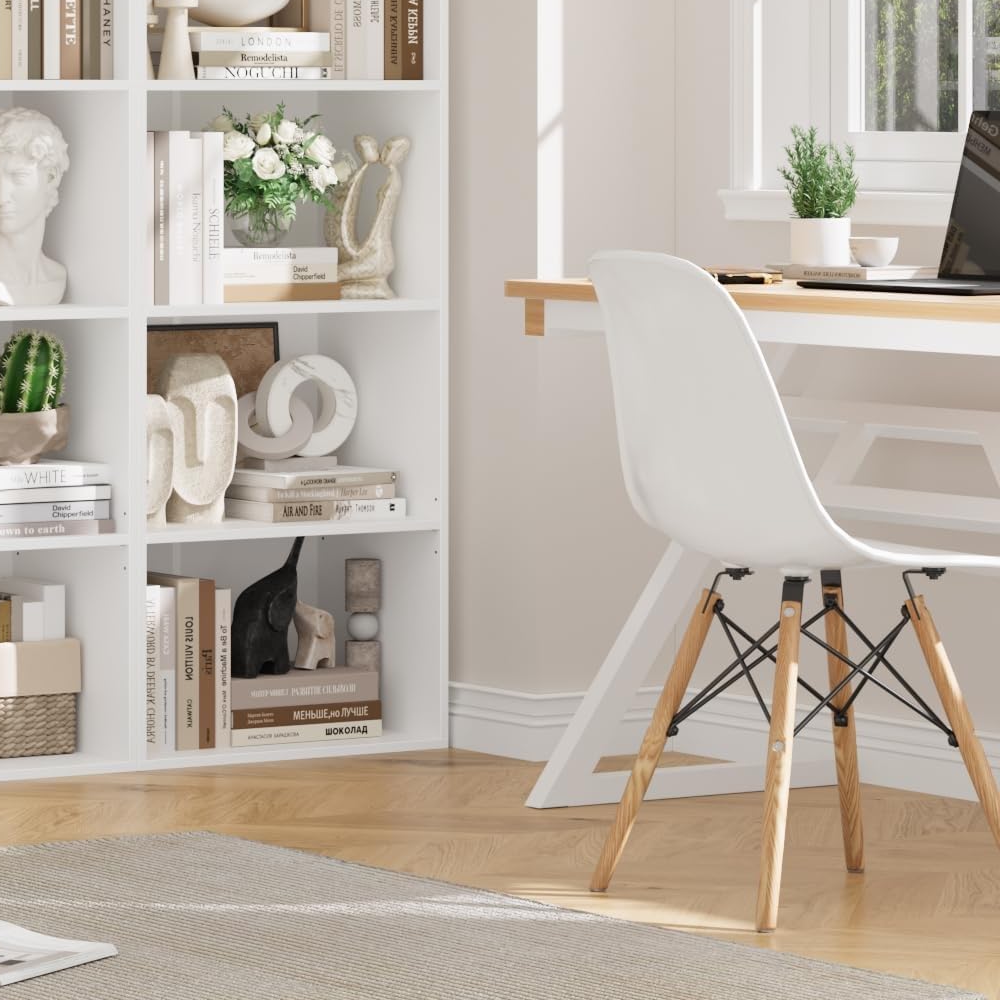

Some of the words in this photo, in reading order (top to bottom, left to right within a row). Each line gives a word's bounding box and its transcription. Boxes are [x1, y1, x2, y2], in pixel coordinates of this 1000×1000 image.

[241, 36, 293, 47] LONDON
[241, 53, 288, 62] Remodelista
[225, 66, 299, 79] NOGUCHI
[293, 273, 326, 281] Chipperfield
[24, 469, 66, 484] WHITE
[52, 510, 94, 519] Chipperfield
[295, 505, 308, 517] AND
[310, 504, 322, 517] FIRE
[25, 525, 35, 535] to
[38, 524, 66, 534] earth
[341, 706, 369, 717] ЛУЧШЕ
[325, 725, 368, 736] ШОКОЛАД
